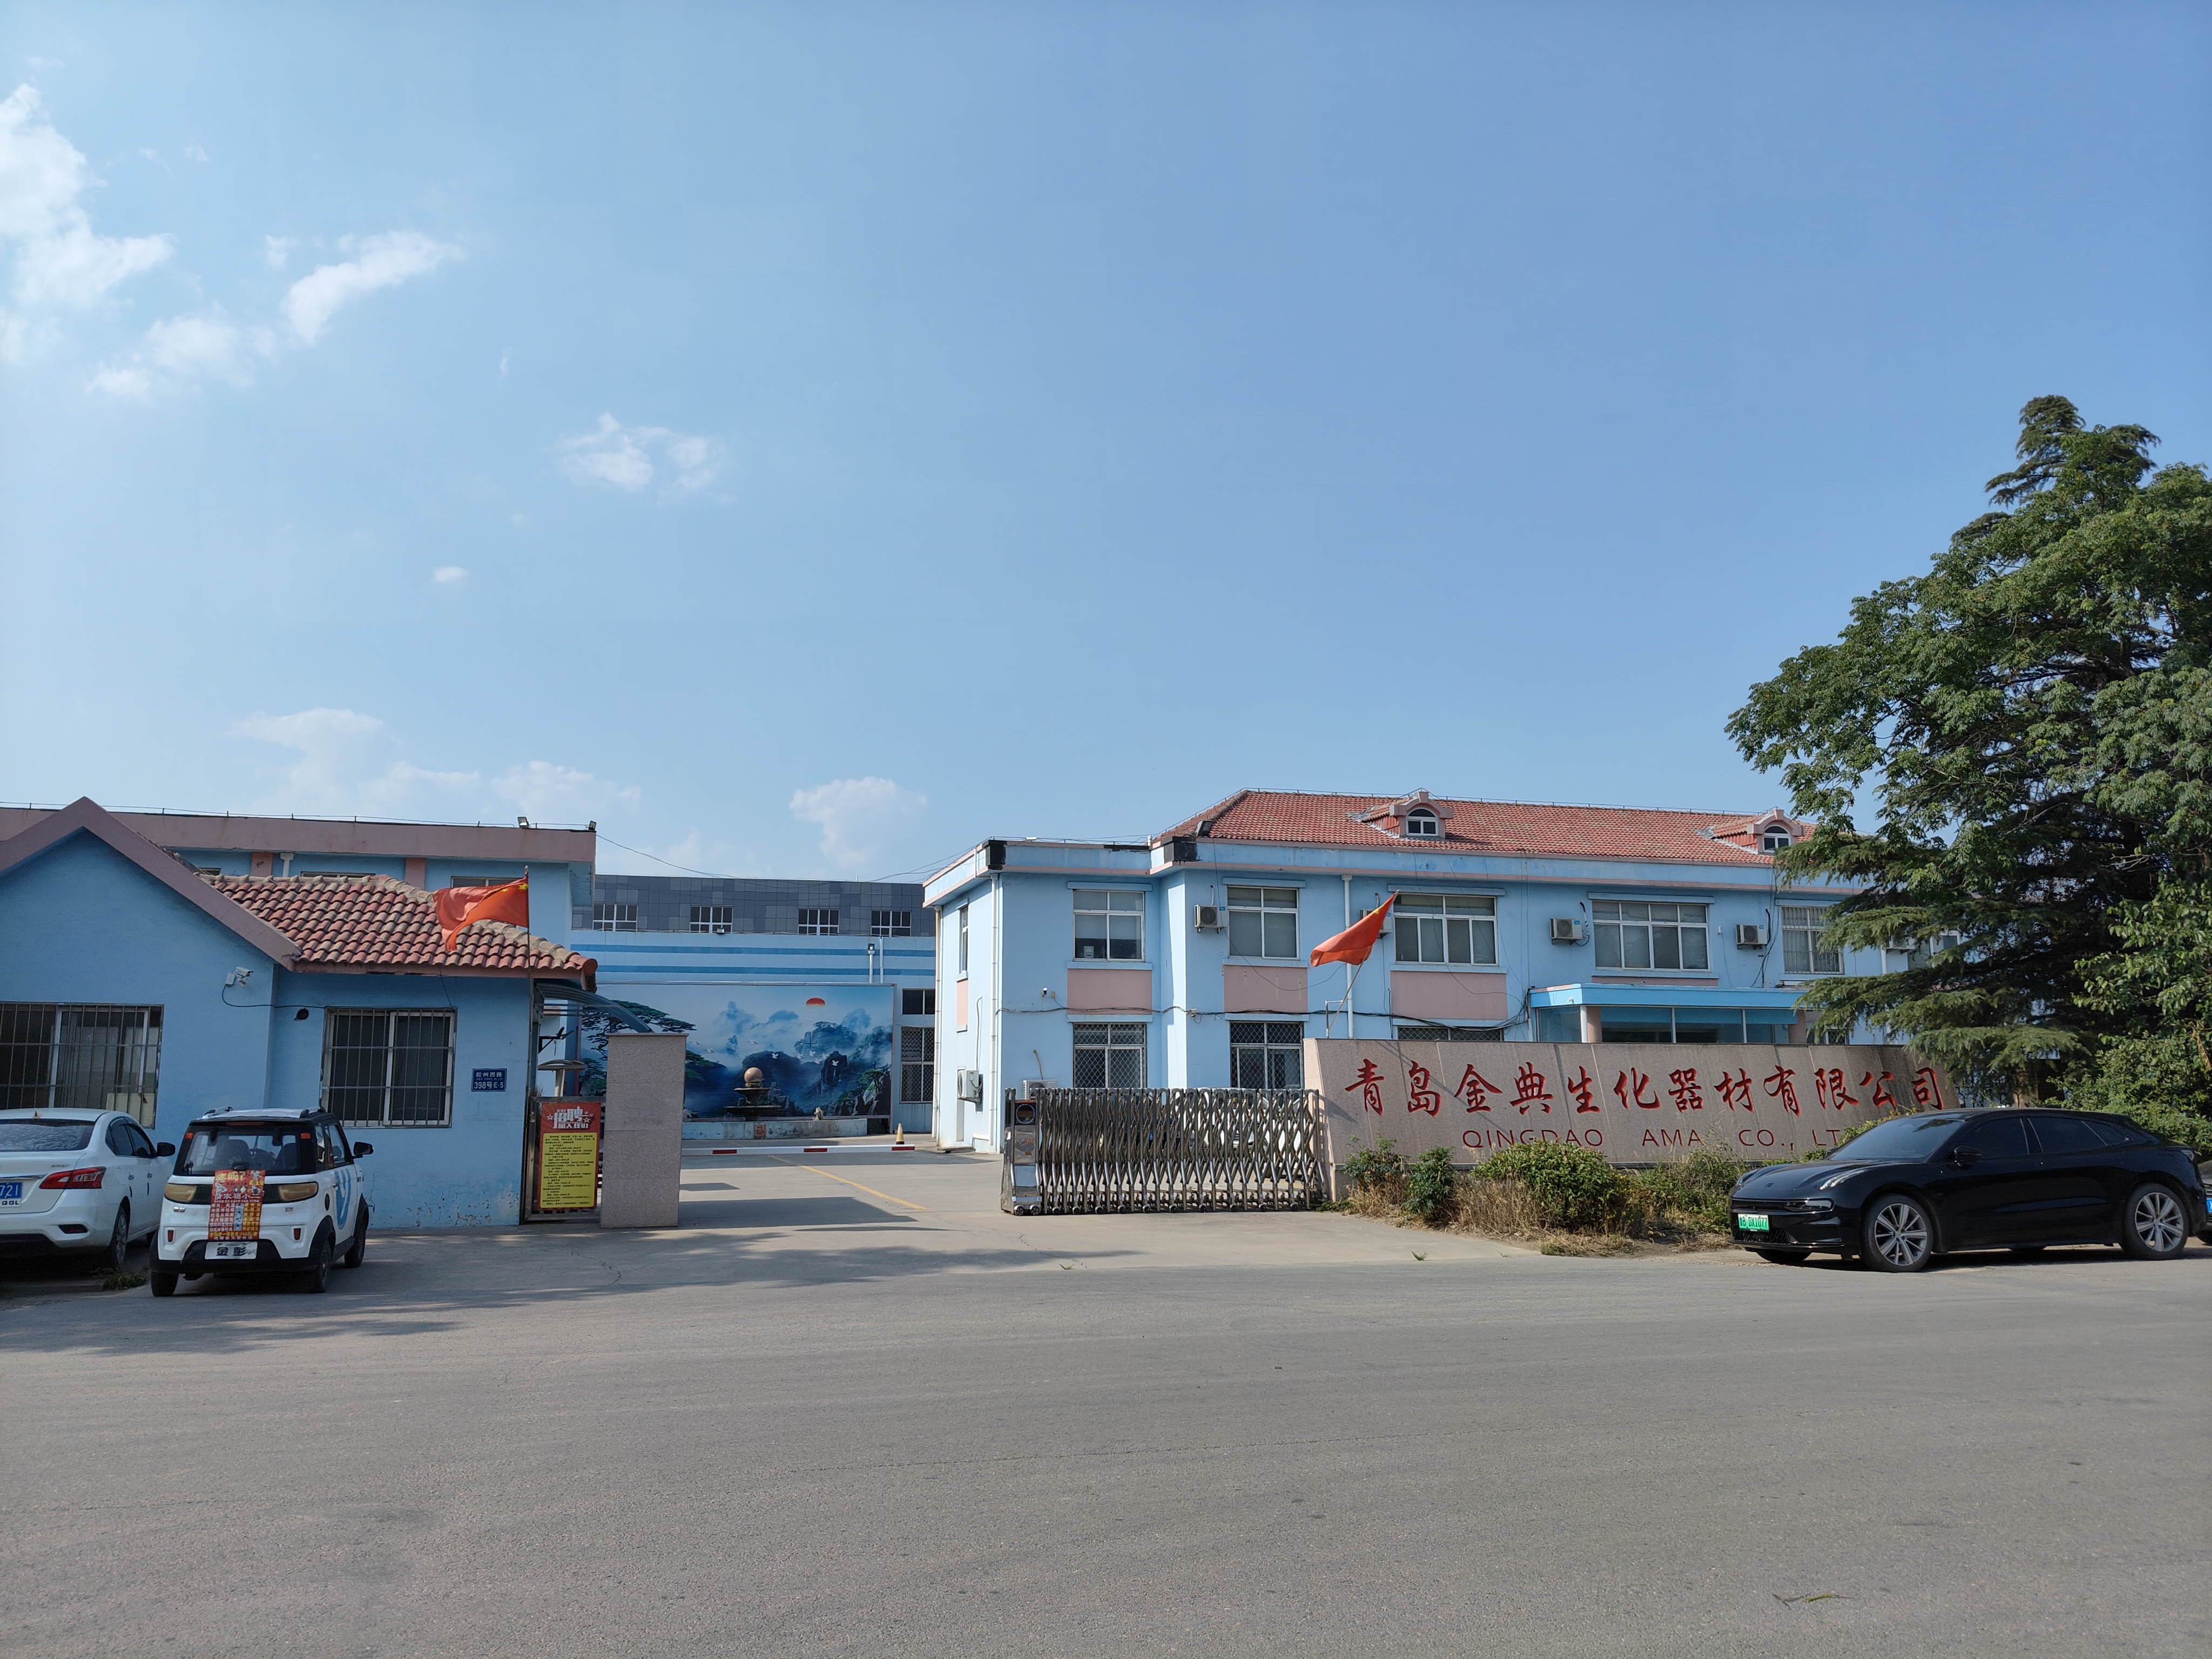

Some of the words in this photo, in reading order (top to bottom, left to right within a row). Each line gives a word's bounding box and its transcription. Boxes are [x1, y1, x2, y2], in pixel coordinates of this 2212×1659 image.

[1345, 1058, 1944, 1117] 青岛金典生化器材有限公司
[553, 1106, 589, 1129] 招聘
[1462, 1129, 1603, 1148] QINGDAO
[1642, 1129, 1705, 1147] AMA
[1812, 1130, 1840, 1147] LT
